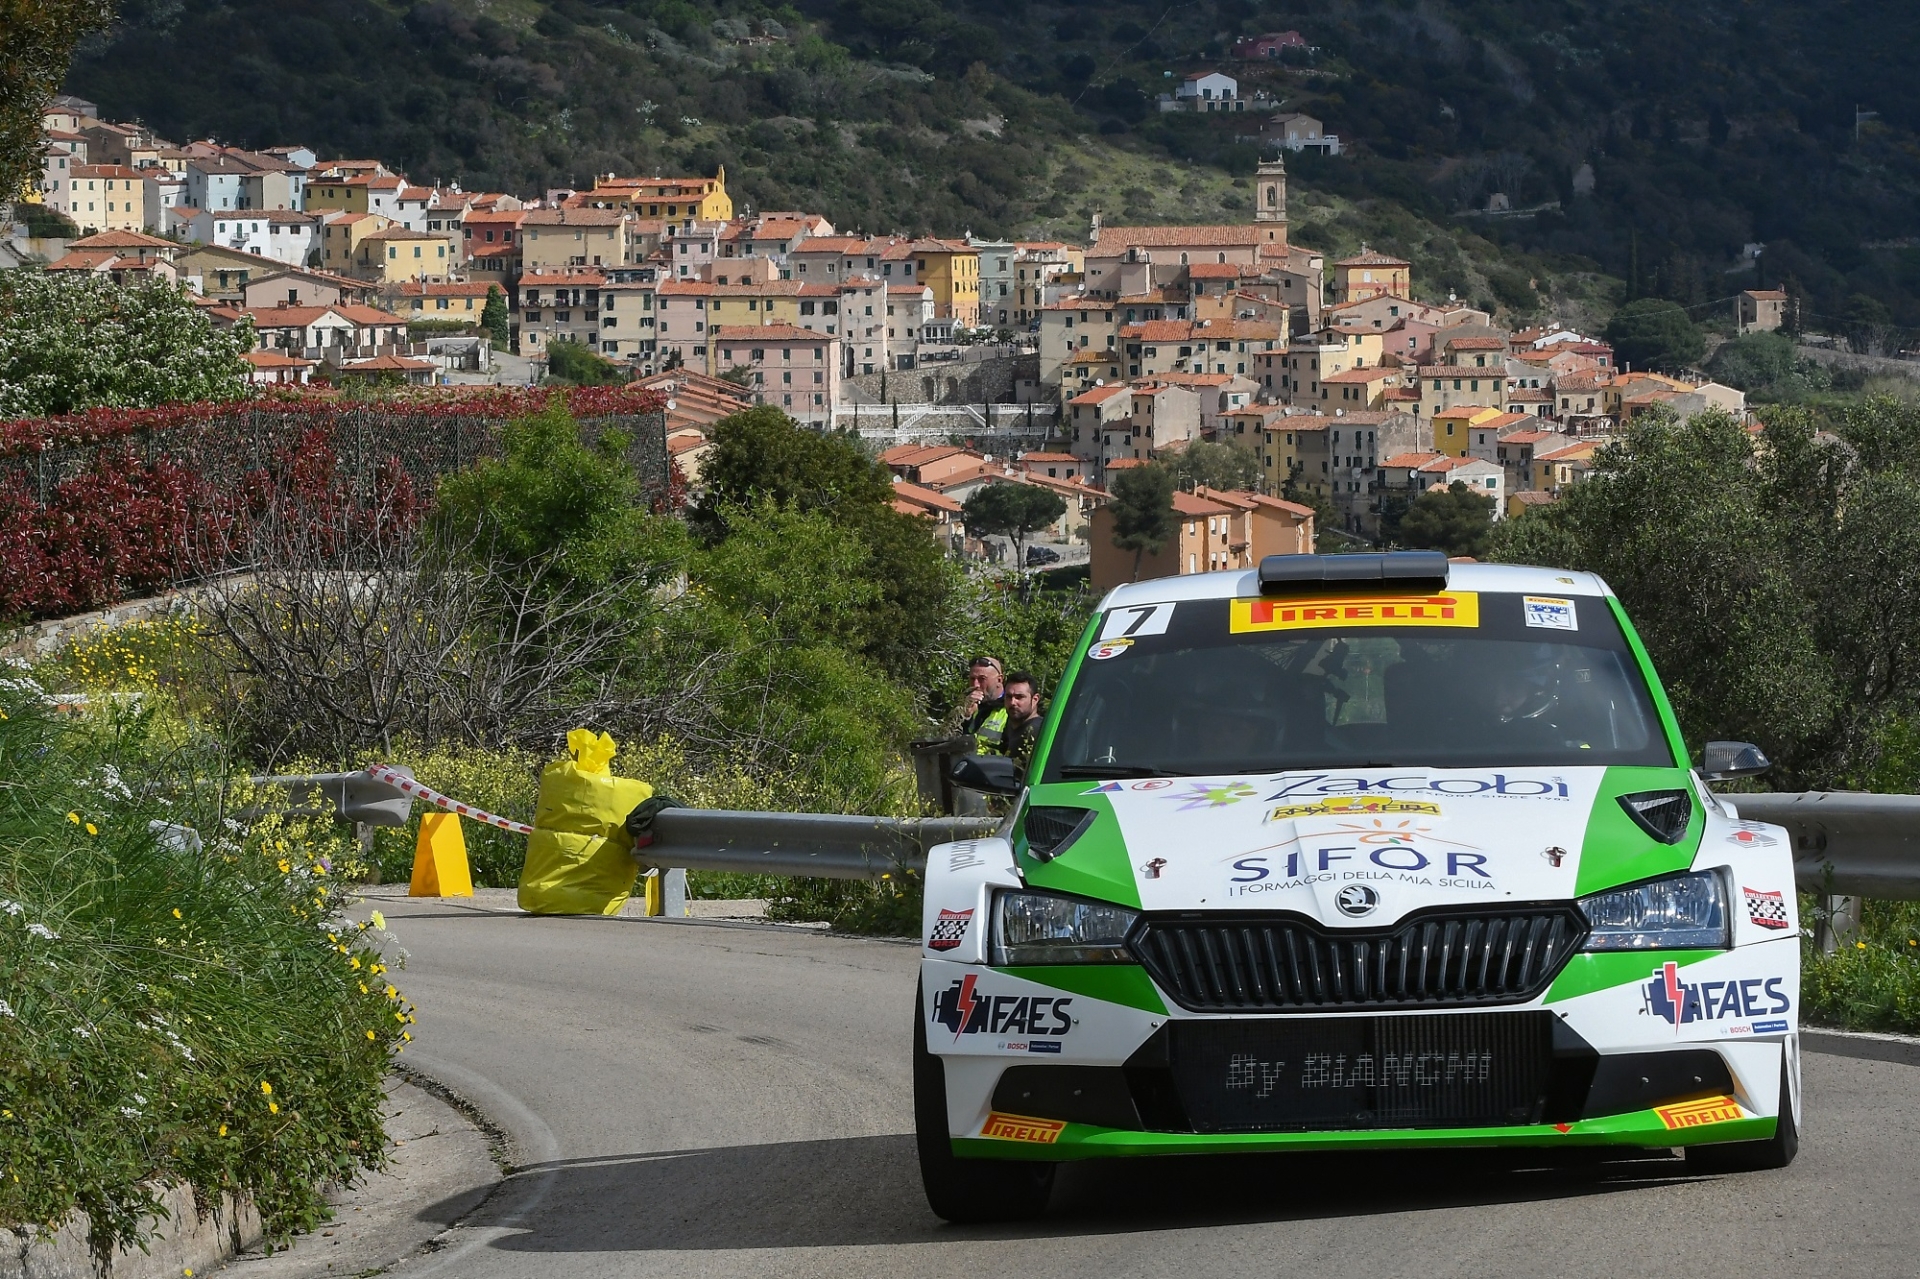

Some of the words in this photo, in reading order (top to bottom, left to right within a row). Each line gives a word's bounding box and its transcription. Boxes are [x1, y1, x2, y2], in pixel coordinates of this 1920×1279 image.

[1122, 606, 1158, 635] 7
[1251, 596, 1457, 624] PIRELLI
[1098, 648, 1112, 657] S
[1264, 774, 1568, 801] Zacobi
[1415, 790, 1475, 798] EXPORT
[1230, 847, 1492, 882] SIFOR
[1229, 887, 1233, 896] I
[1240, 873, 1337, 896] FORMAGGI
[1343, 871, 1394, 880] DELLA
[1399, 873, 1433, 886] MIA
[1439, 878, 1496, 890] SICILIA
[1752, 917, 1788, 928] CORSE
[1701, 977, 1790, 1020] FAES
[990, 996, 1073, 1036] FAES
[1302, 1048, 1492, 1088] BIANCHI
[981, 1112, 1064, 1143] PIRELLI
[1657, 1097, 1743, 1129] PIRELLI
